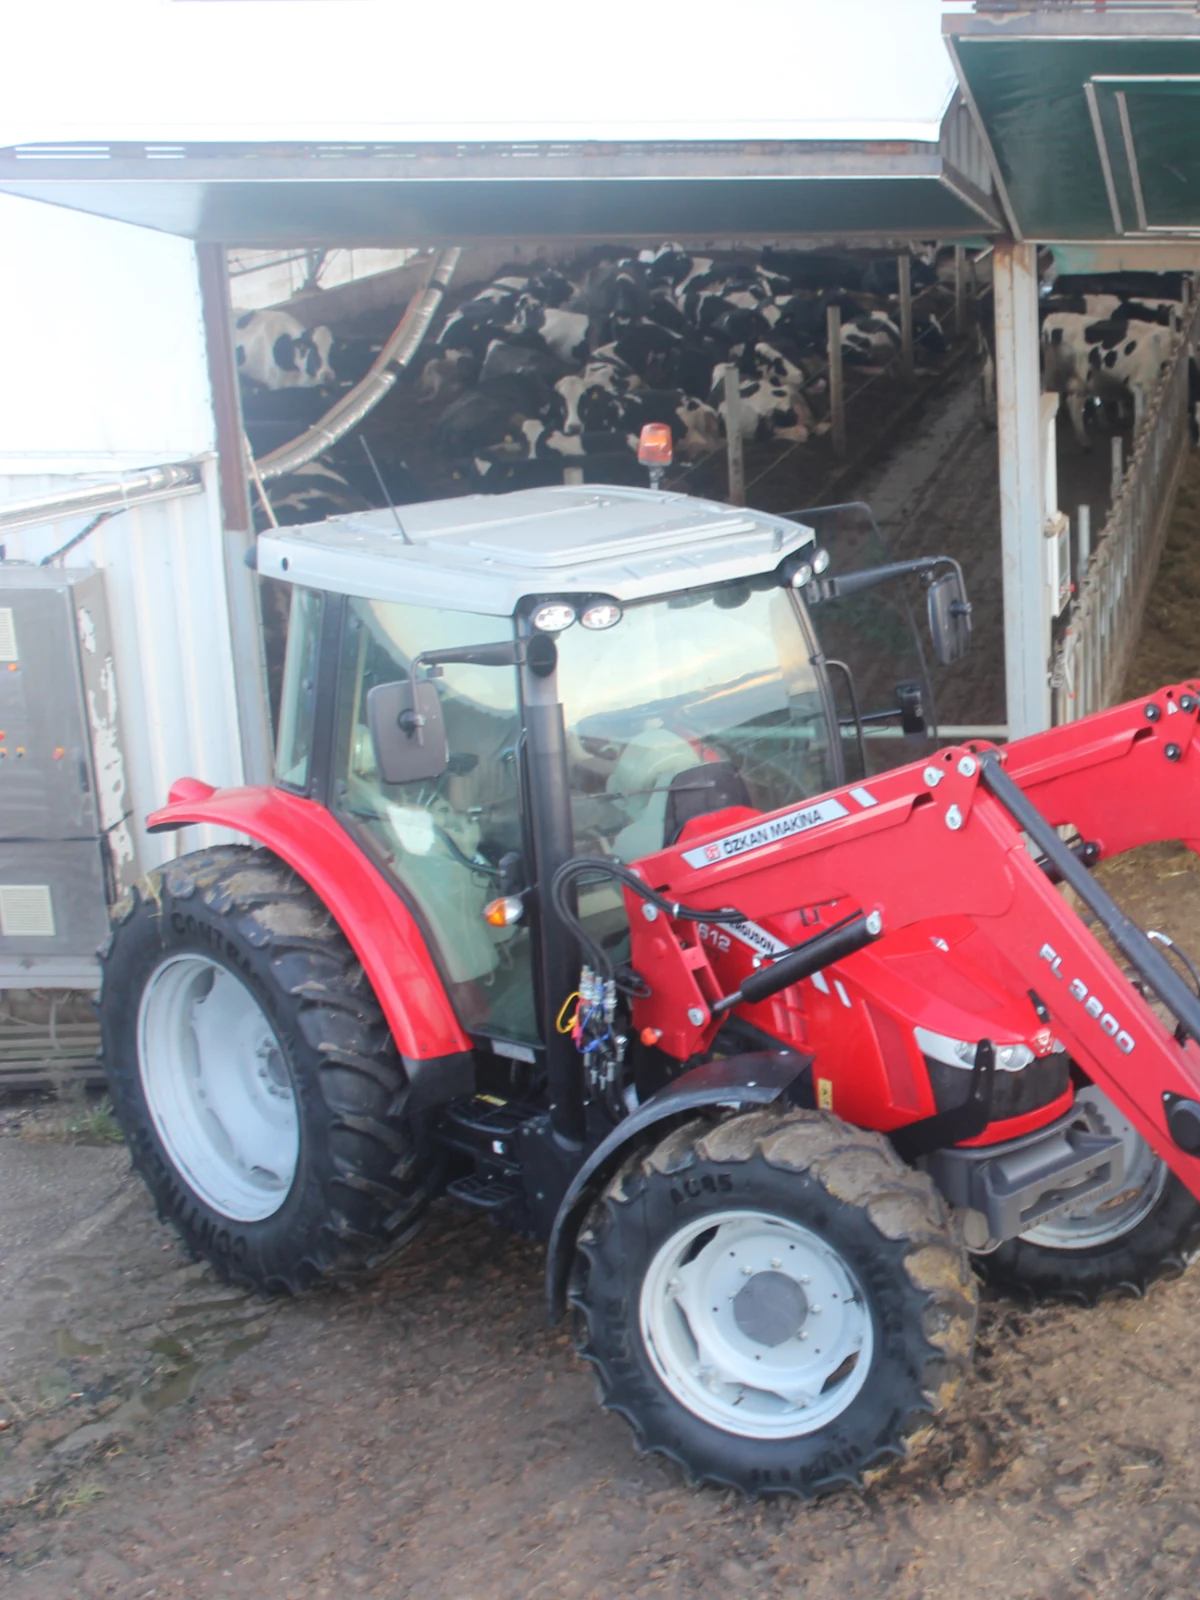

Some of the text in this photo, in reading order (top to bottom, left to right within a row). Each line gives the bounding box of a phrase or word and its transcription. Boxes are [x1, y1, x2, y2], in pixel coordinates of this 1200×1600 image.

[723, 829, 768, 855] ÖZKAN
[1039, 943, 1136, 1056] FL 3800
